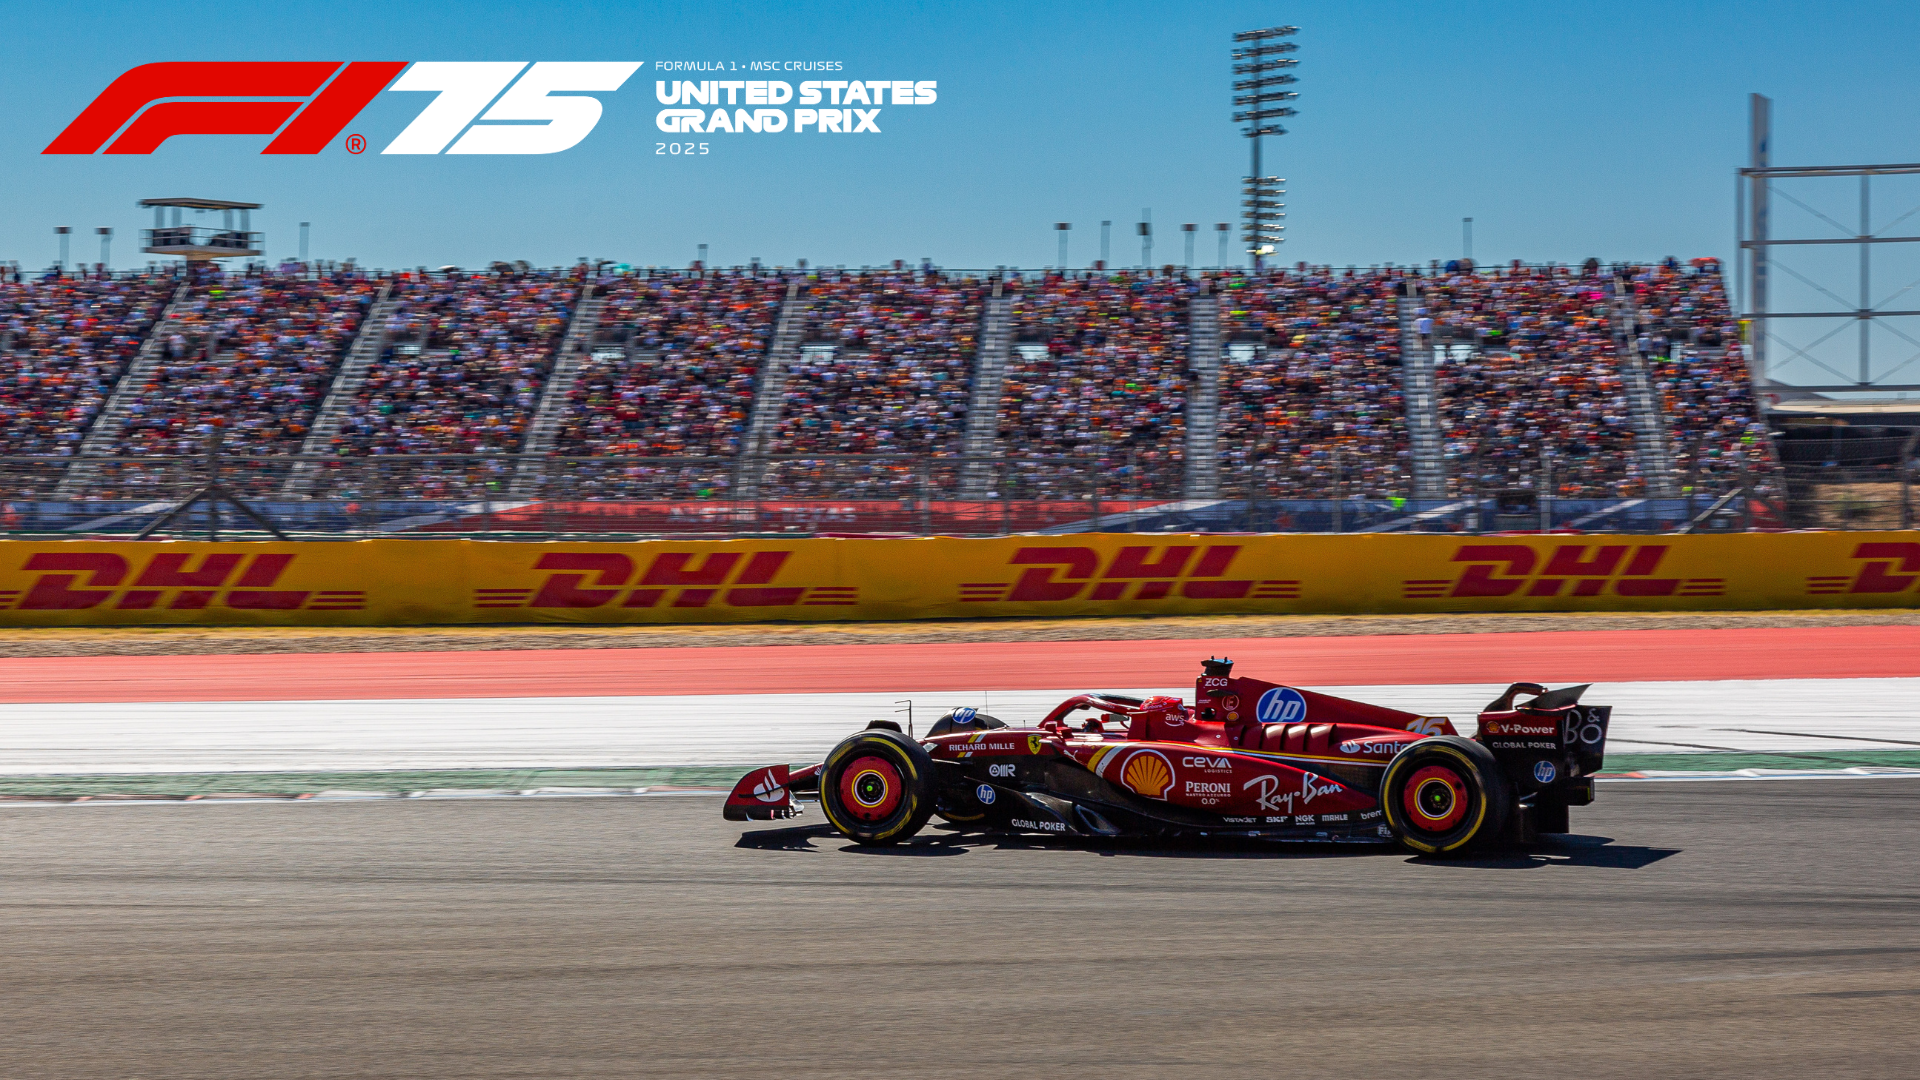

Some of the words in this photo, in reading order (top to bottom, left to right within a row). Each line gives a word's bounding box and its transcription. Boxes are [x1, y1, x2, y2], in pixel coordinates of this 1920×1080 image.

[1006, 545, 1257, 601] DHL
[1450, 545, 1684, 597] DHL
[17, 552, 311, 610] DHL
[530, 551, 805, 608] DHL
[1205, 678, 1228, 687] ZCG
[1262, 687, 1301, 722] hp
[955, 708, 972, 722] hp
[1165, 713, 1185, 722] aws
[1500, 724, 1554, 734] V-Power
[949, 743, 987, 751] RICHARD
[1492, 741, 1527, 749] GLOBAL
[1528, 741, 1556, 749] POKER
[1537, 763, 1552, 783] hp
[980, 785, 993, 804] hp
[1185, 781, 1231, 793] PERONI
[1243, 772, 1343, 814] Ray-Ban
[1011, 819, 1038, 829] GLOBAL
[1039, 821, 1066, 831] POKER
